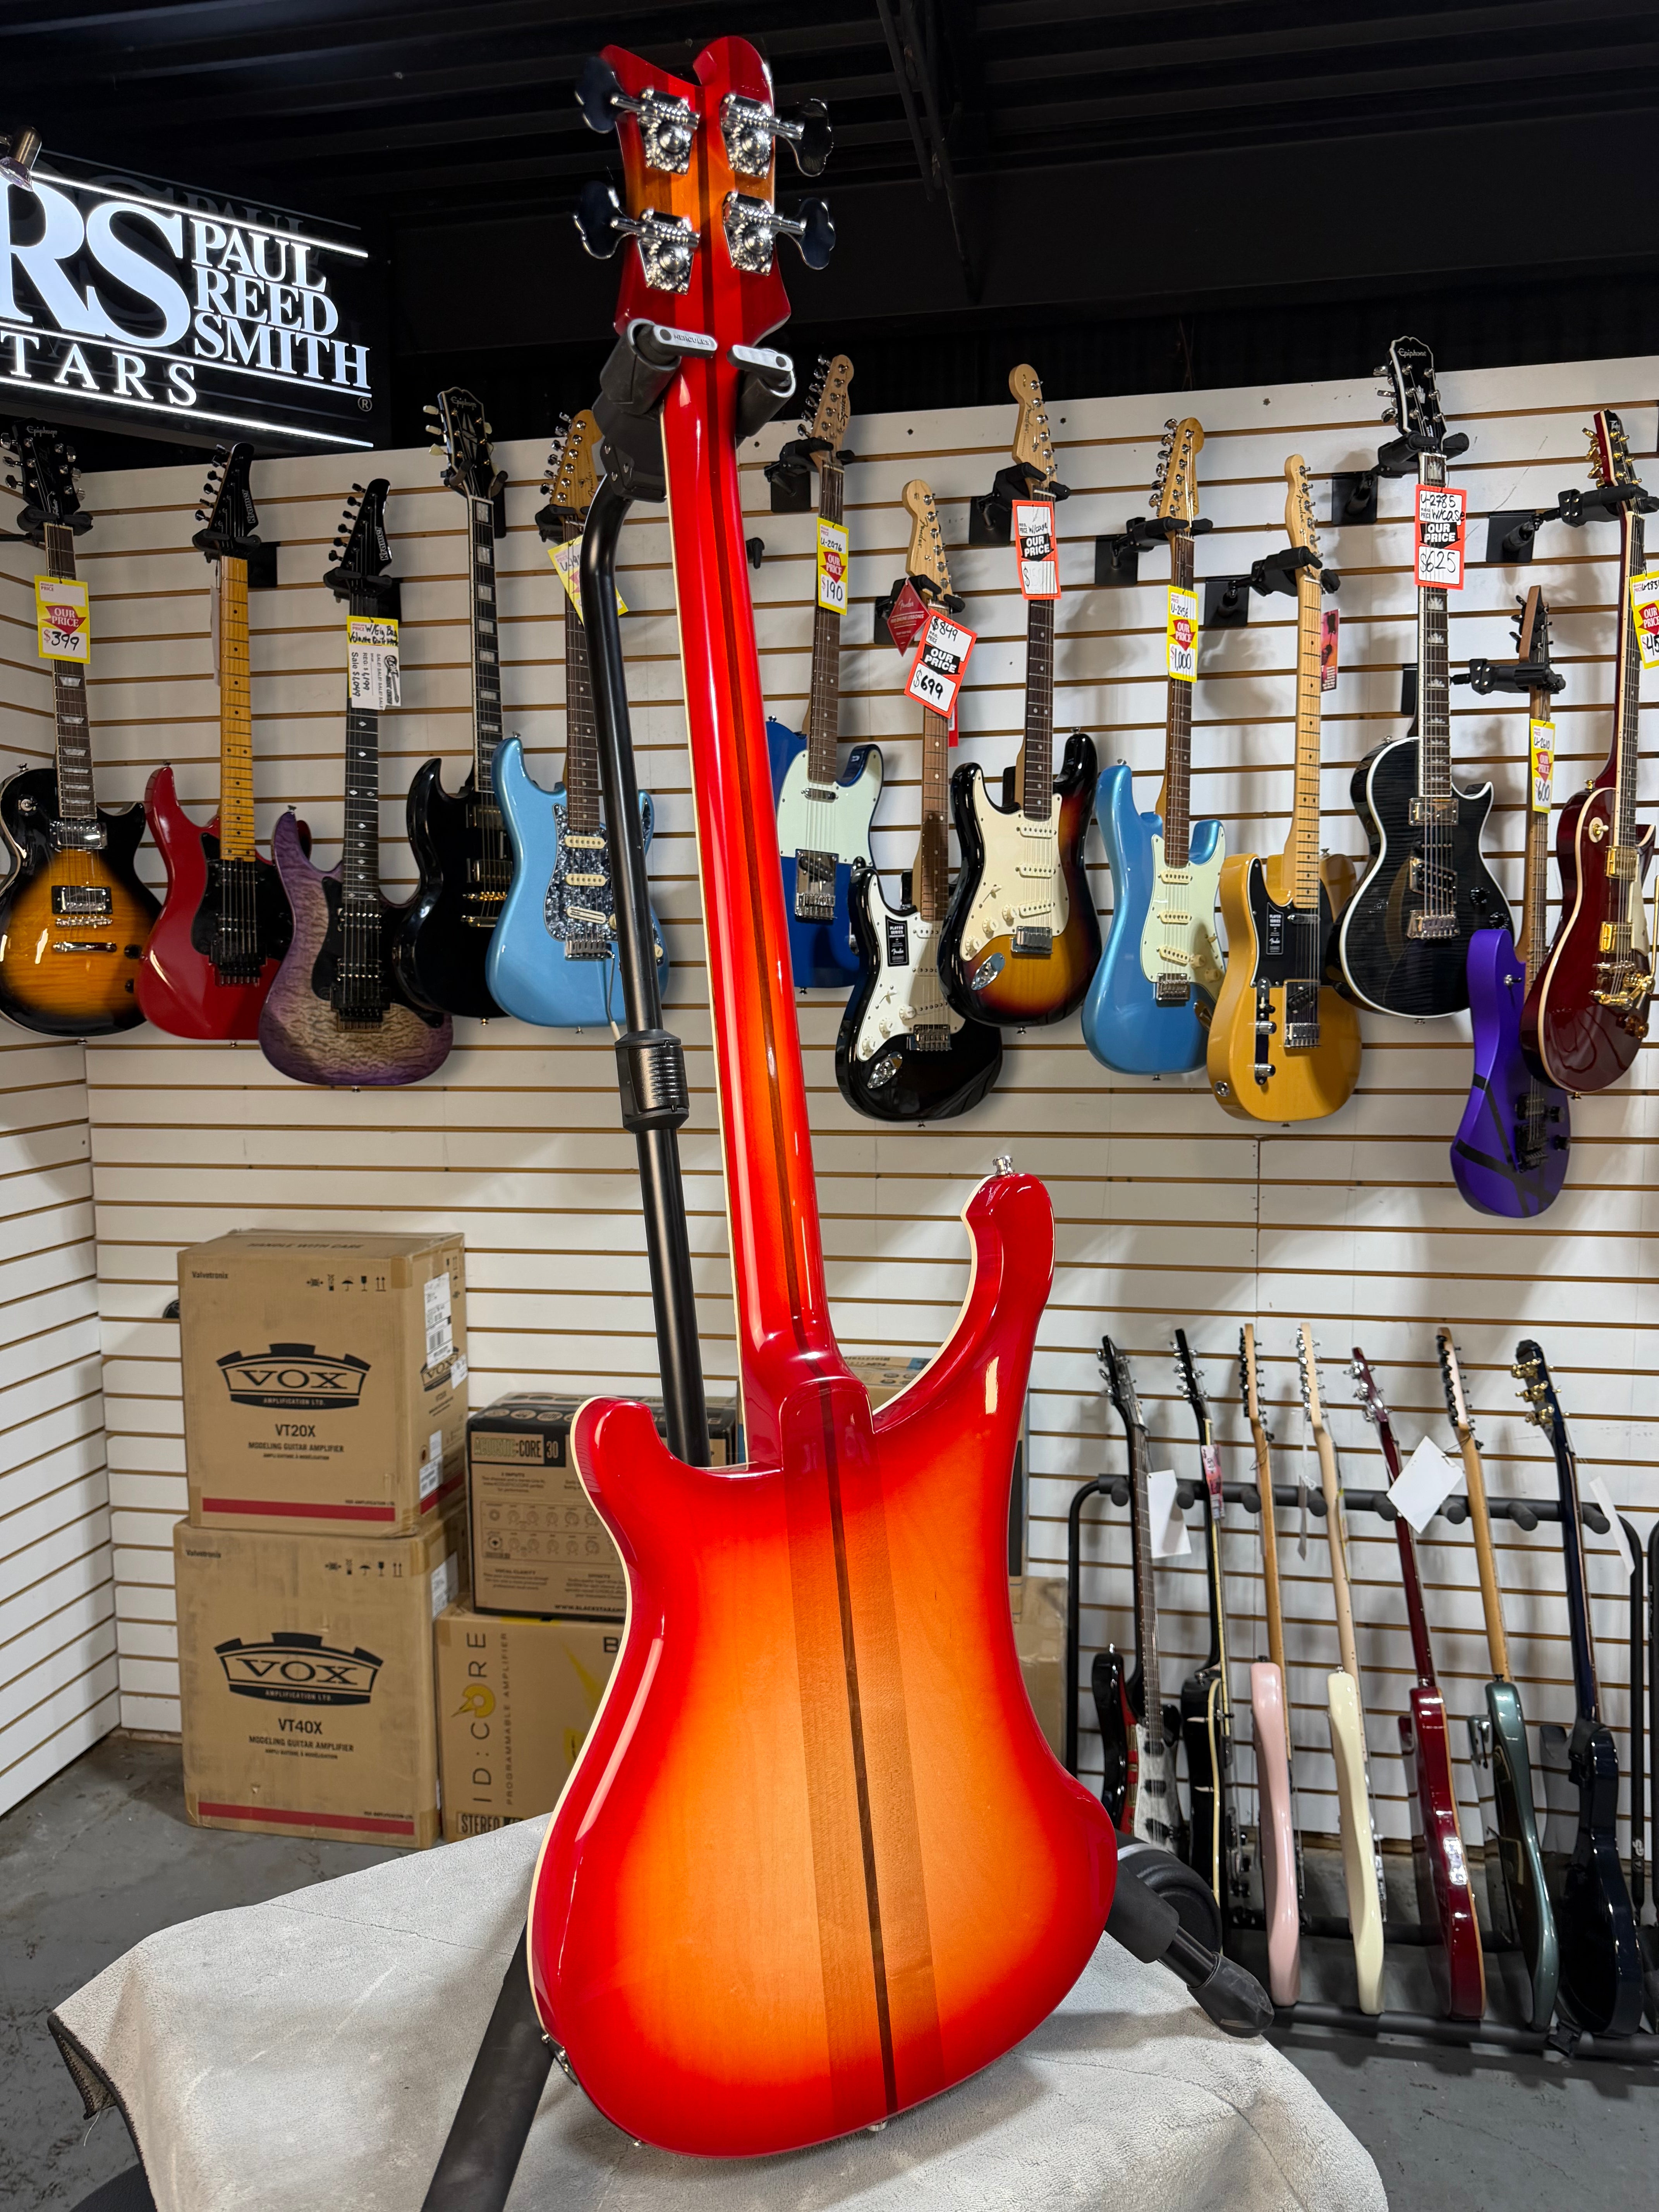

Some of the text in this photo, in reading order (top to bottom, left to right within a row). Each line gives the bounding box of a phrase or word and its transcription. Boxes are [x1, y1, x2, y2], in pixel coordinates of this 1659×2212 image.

[190, 218, 326, 292] PAUL
[192, 265, 338, 336] REED
[673, 333, 710, 345] HERCULES
[194, 314, 371, 389] SMITH
[1397, 348, 1427, 358] Epiphone
[0, 331, 197, 407] TARS
[26, 425, 58, 438] Epiphone
[242, 489, 256, 524] Kramer
[919, 517, 928, 548] Fender
[1428, 523, 1450, 533] OUR
[375, 526, 389, 561] Kramer
[1026, 536, 1044, 548] OUR
[1424, 532, 1456, 543] PRICE
[1024, 544, 1050, 557] PRICE
[828, 554, 841, 566] OUR
[1420, 550, 1456, 574] $625
[826, 562, 843, 576] PRICE
[821, 577, 843, 601] $190
[54, 608, 75, 618] OUR
[1644, 607, 1658, 618] OUR
[52, 616, 79, 627] PRICE
[931, 615, 958, 642] $849
[1177, 622, 1190, 634] OUR
[1643, 616, 1659, 629] PRICE
[44, 629, 80, 651] $399
[927, 635, 938, 644] PRICE
[1175, 631, 1192, 643] PRICE
[931, 648, 954, 663] OUR
[1170, 646, 1191, 671] $1,000
[924, 654, 957, 673] PRICE
[352, 672, 361, 697] $1,049
[913, 669, 943, 700] $699
[1539, 754, 1549, 764] OUR
[1539, 763, 1549, 775] PRICE
[192, 1271, 228, 1279] Valvetronix
[237, 1369, 348, 1389] VOX
[263, 1397, 310, 1405] AMPLIFICATION
[275, 1424, 316, 1437] VT20X
[248, 1441, 282, 1450] MODELING
[309, 1444, 344, 1453] AMPLIFIER
[546, 1440, 559, 1459] 30
[236, 1658, 358, 1685] VOX
[500, 1633, 510, 1698] AMPLIFIER
[265, 1690, 316, 1700] AMPLIFICATION
[278, 1718, 323, 1735] VT40X
[249, 1735, 354, 1752] MODELING GUITAR AMPLIFIER
[503, 1704, 514, 1805] PROGRAMMABLE
